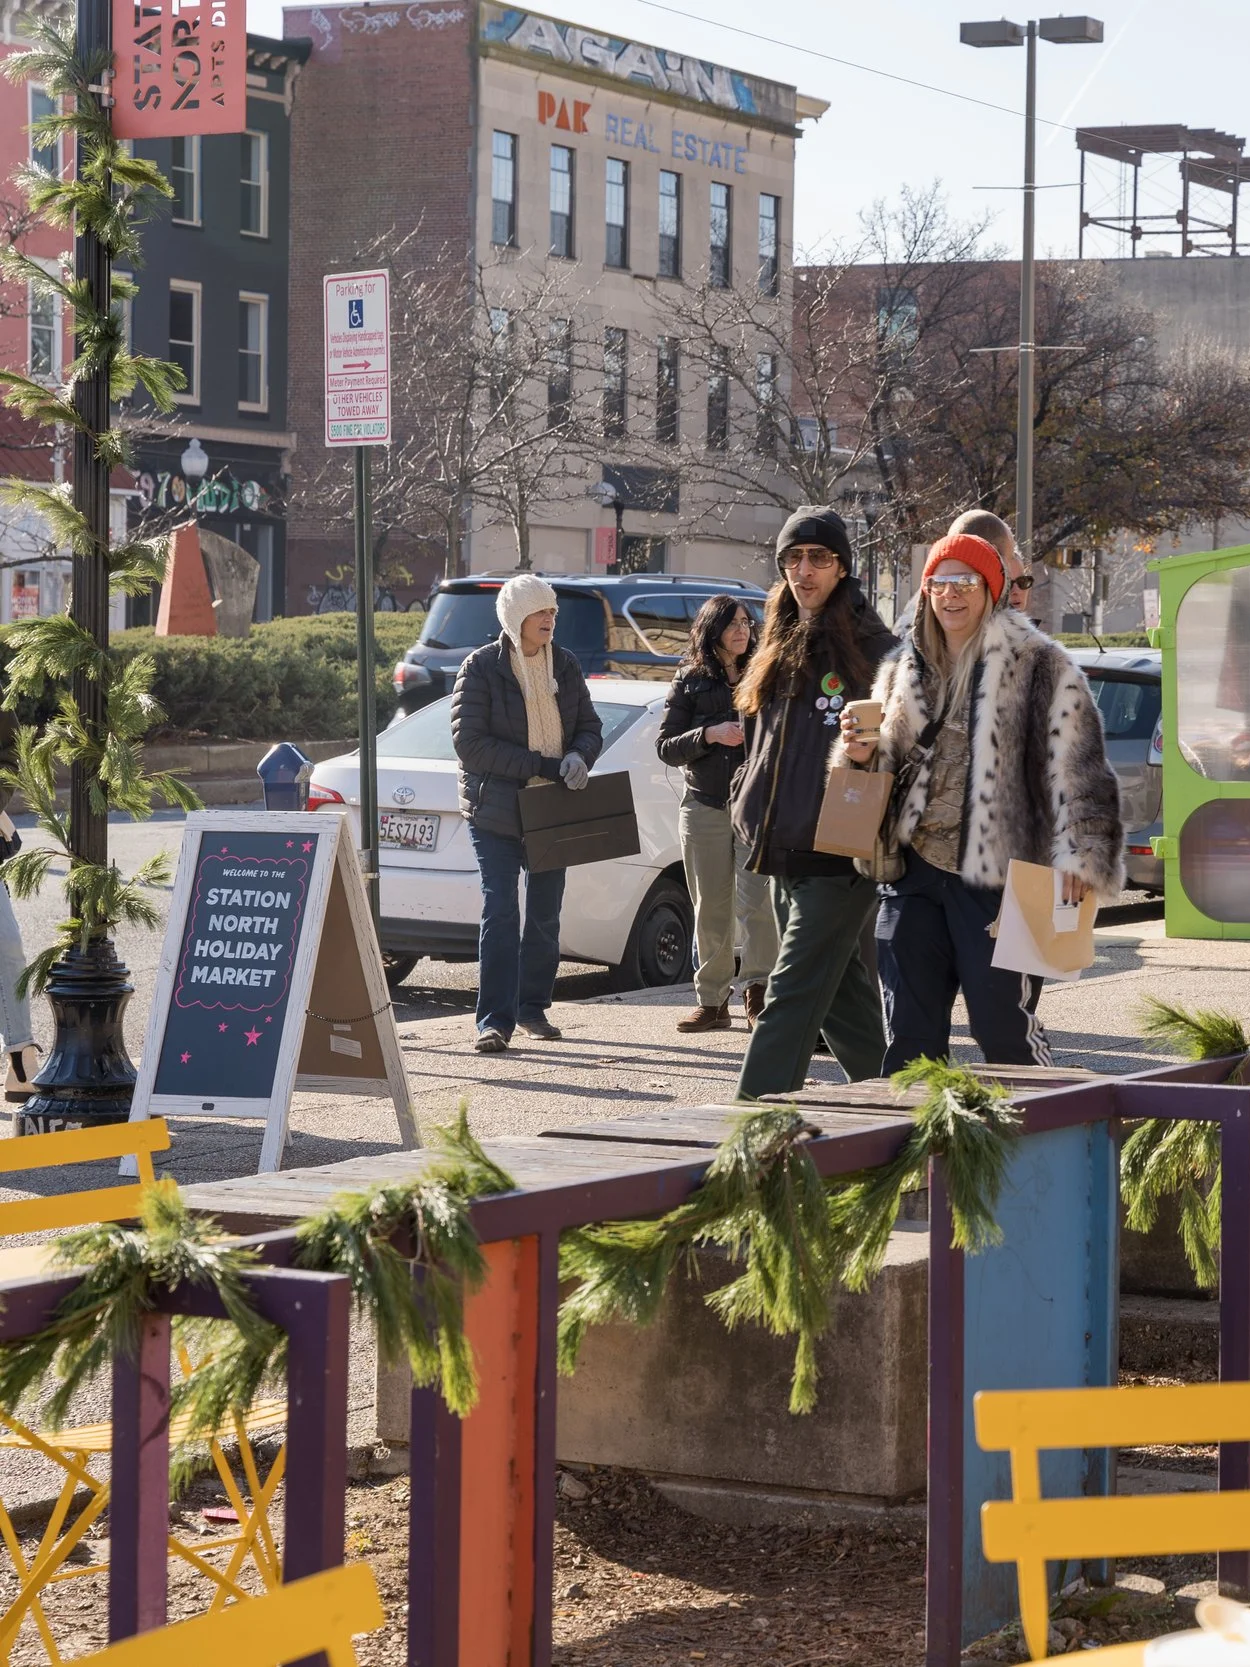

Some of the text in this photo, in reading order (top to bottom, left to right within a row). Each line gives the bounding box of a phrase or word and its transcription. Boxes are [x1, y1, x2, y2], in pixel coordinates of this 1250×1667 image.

[538, 90, 748, 175] PAK REAL ESTATE
[335, 280, 376, 298] Parking for
[330, 373, 386, 389] Meter Payment Required
[333, 391, 383, 405] OTHER VEHICLES
[337, 404, 380, 417] TOWED AWAY
[342, 424, 353, 436] FINE
[363, 421, 386, 436] VIOLATORS
[379, 821, 435, 846] 5ES7193
[222, 868, 286, 879] WELCOME TO THE
[205, 887, 292, 909] STATION
[208, 914, 279, 935] NORTH
[194, 939, 283, 961] HOLIDAY
[190, 965, 277, 988] MARKET
